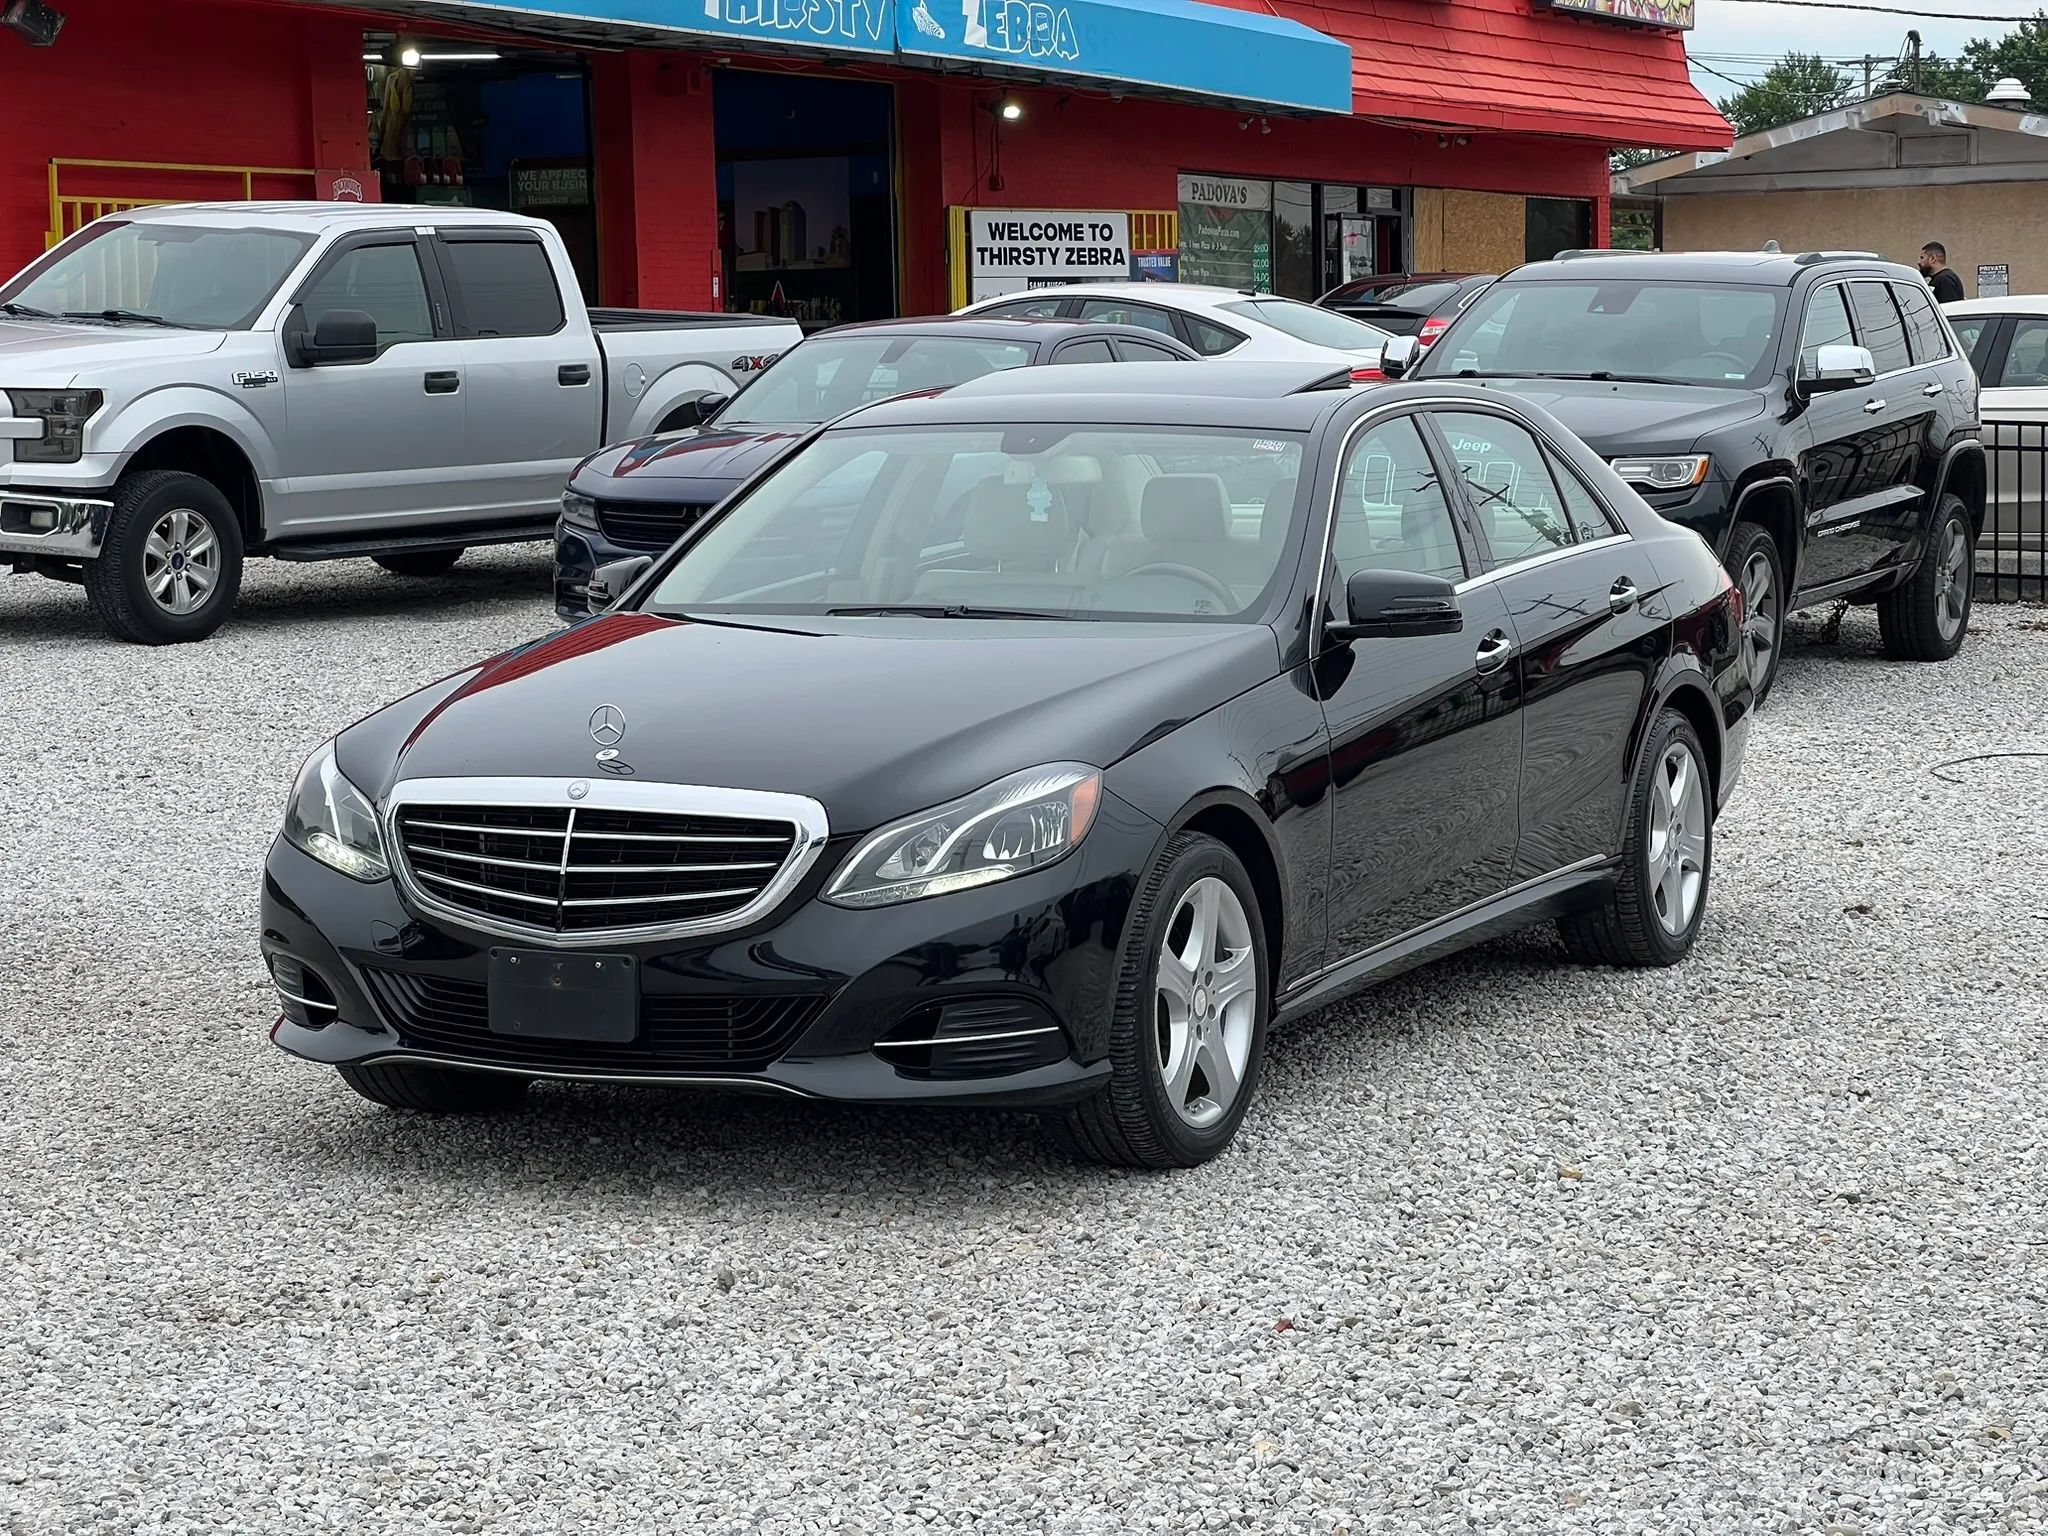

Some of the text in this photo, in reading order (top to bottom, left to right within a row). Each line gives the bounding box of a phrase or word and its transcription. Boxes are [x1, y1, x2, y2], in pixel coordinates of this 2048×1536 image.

[962, 0, 1079, 60] ZEBRA
[517, 179, 588, 192] YOUR BUSIN
[518, 171, 537, 181] WE
[1191, 182, 1248, 204] PADOVA'S
[987, 222, 1114, 242] WELCOME TO
[976, 247, 1126, 266] THIRSTY ZEBRA
[1452, 438, 1491, 453] Jeep
